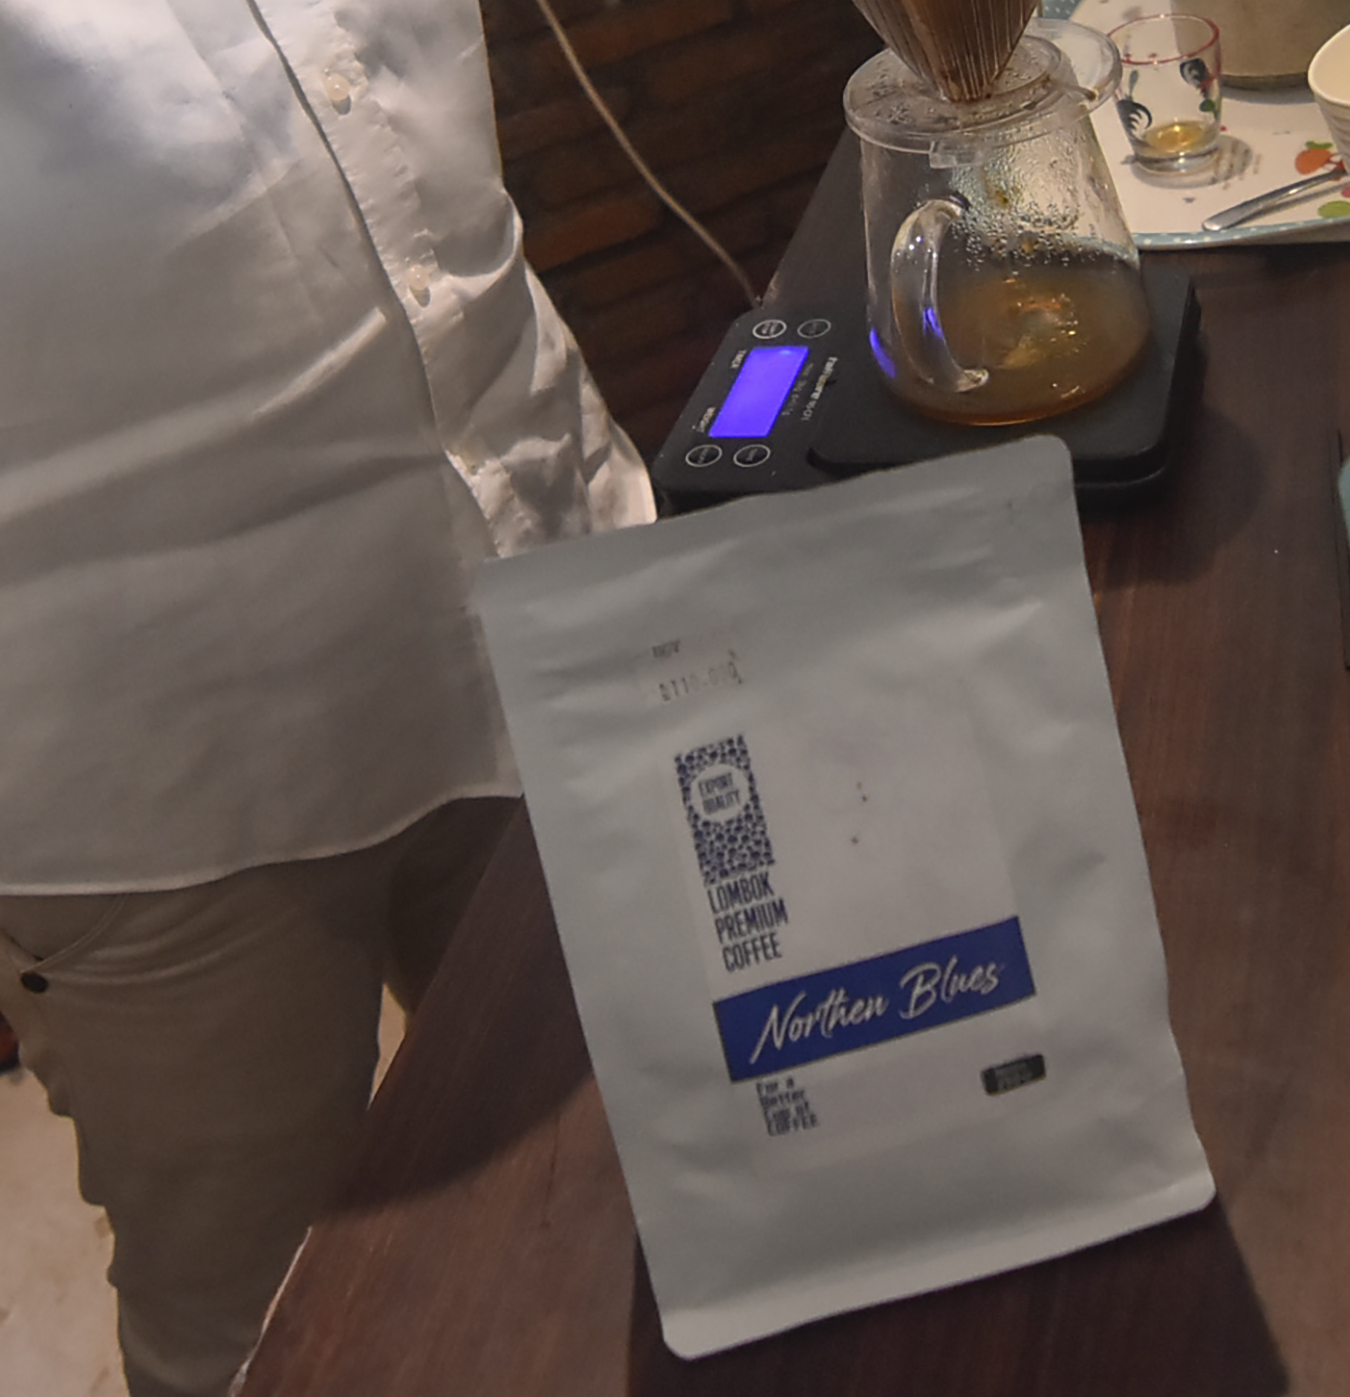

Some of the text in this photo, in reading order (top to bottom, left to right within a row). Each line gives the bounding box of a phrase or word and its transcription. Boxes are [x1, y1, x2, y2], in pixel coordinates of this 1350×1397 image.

[708, 871, 775, 914] LOMBOK
[714, 898, 789, 944] PREMIUM
[722, 932, 783, 973] COFFEE
[750, 955, 1003, 1064] Northen Blues
